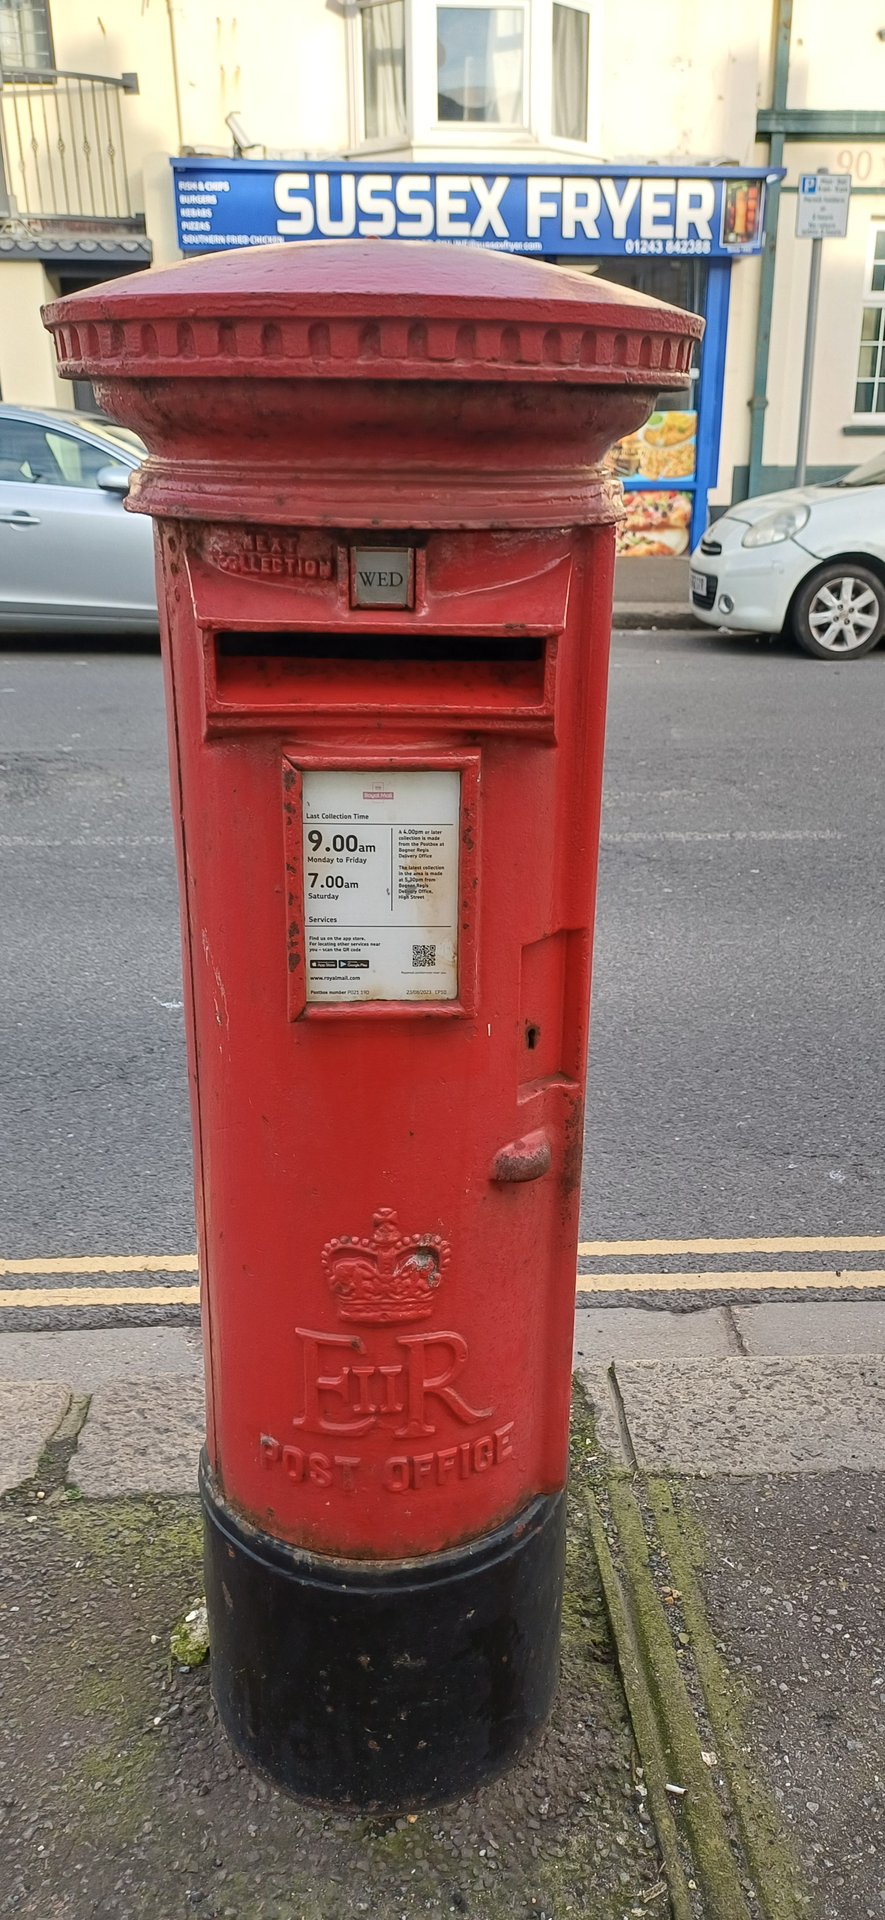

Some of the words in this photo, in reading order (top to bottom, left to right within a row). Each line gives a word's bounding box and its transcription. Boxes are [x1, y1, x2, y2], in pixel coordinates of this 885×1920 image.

[274, 173, 510, 238] SUSSEX
[526, 178, 715, 240] FRYER
[358, 571, 403, 587] WED
[308, 830, 376, 852] 9.00am
[308, 873, 359, 888] 7.00am
[259, 1432, 361, 1492] POST
[384, 1421, 515, 1492] OFFICE
